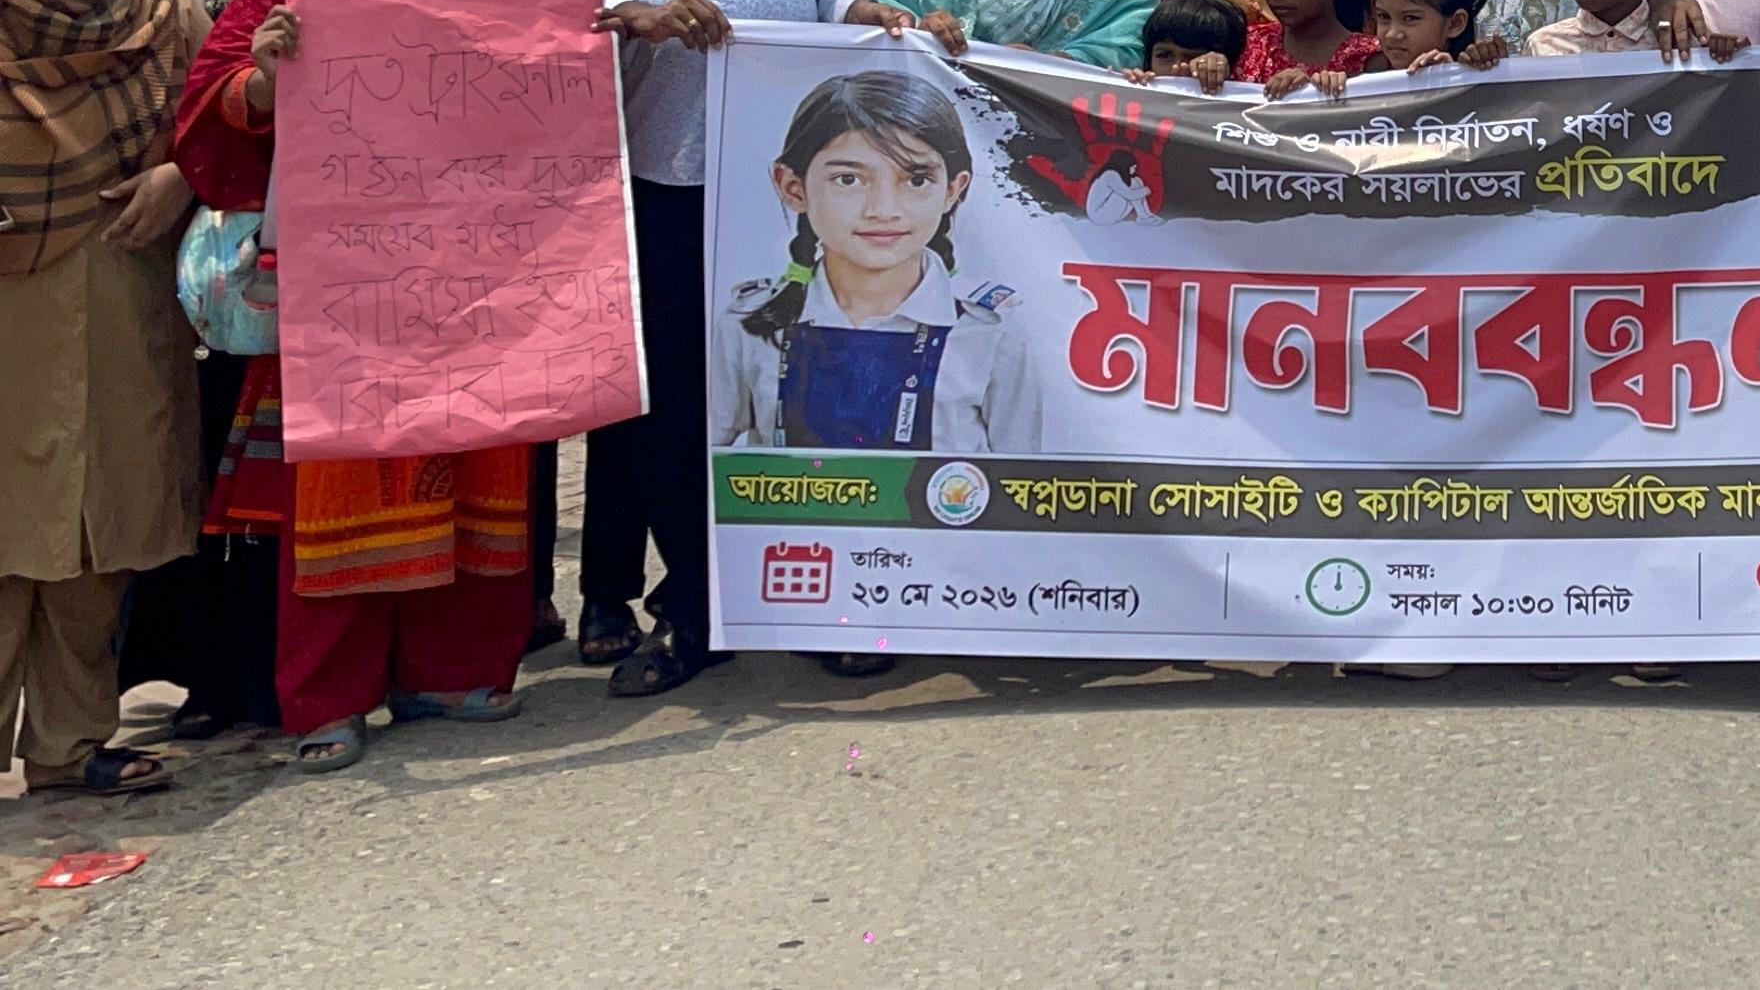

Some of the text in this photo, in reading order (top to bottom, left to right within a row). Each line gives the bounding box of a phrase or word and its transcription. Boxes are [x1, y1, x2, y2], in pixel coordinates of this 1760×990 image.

[1295, 134, 1320, 152] ও
[1413, 111, 1547, 151] নির্যাতন,
[1562, 102, 1634, 143] ধর্ষণ
[1645, 111, 1672, 136] ও
[437, 154, 508, 190] করে
[1210, 145, 1725, 203] মাদকের সয়লাভের প্রতিবাদে
[1000, 476, 1138, 521] স্বপ্নডানা
[1149, 474, 1304, 523] সোসাইটি
[1315, 488, 1343, 518] ও
[1355, 476, 1514, 522] ক্যাপিটাল
[1521, 473, 1710, 523] আন্তর্জাতিক
[852, 579, 1139, 617] ২৩ মে ২০২৬ (শনিবার)
[1389, 585, 1634, 616] সকাল ১০:৩০ মিনিট
